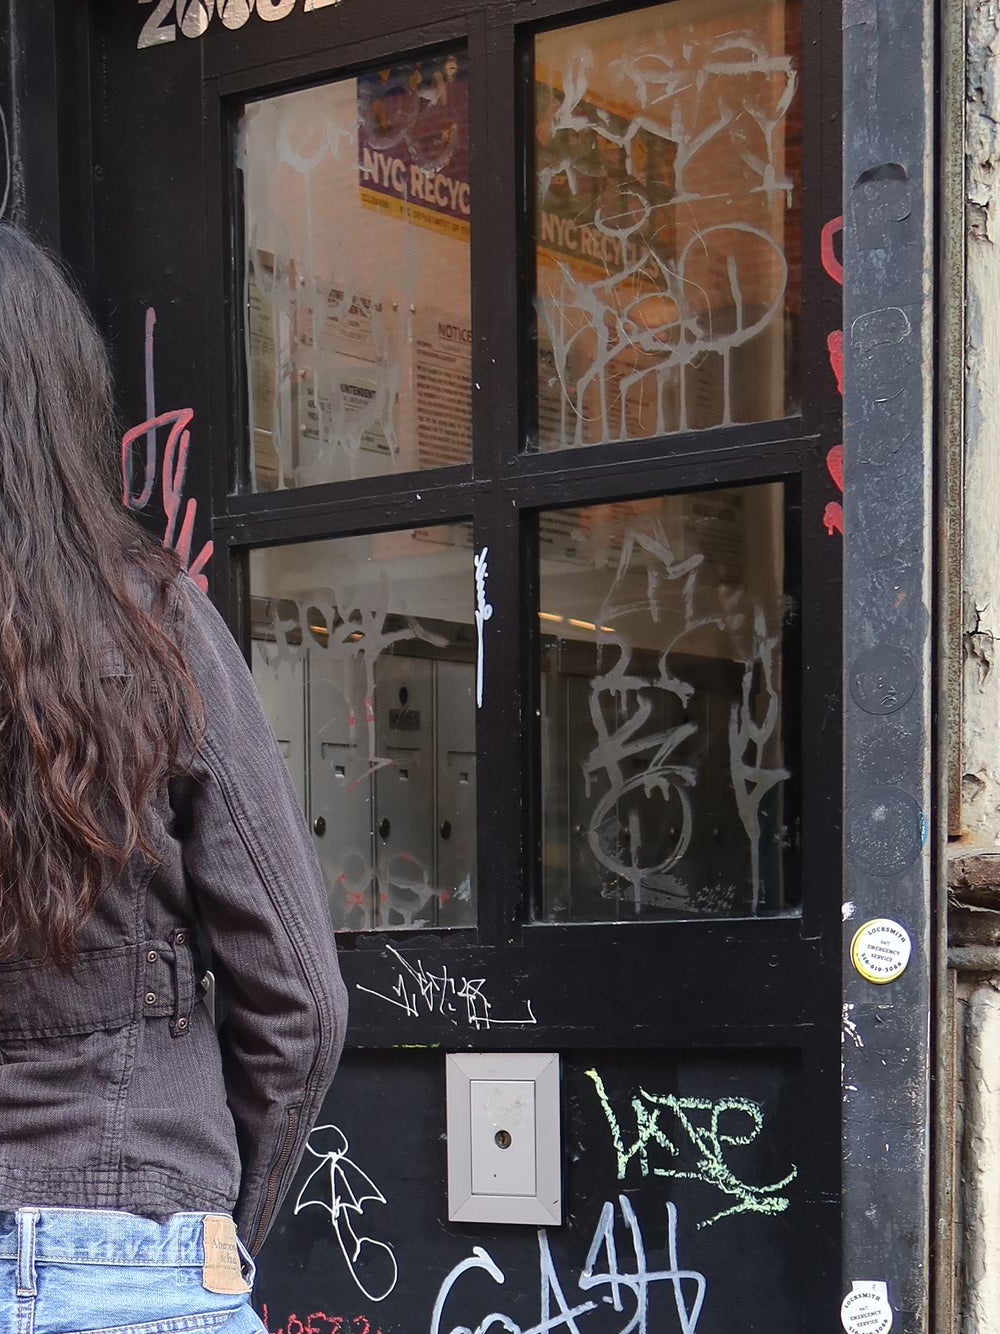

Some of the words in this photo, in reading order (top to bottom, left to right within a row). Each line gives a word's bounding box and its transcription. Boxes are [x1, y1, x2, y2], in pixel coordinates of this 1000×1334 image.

[362, 147, 406, 194] NYC
[868, 926, 906, 943] LOCKSMITH
[867, 944, 900, 955] EMERGENCY
[871, 953, 893, 962] SERVICE
[845, 1292, 881, 1308] LOCKSMITH
[850, 1310, 881, 1321] EMERGENCY
[857, 1319, 878, 1327] SERVICE
